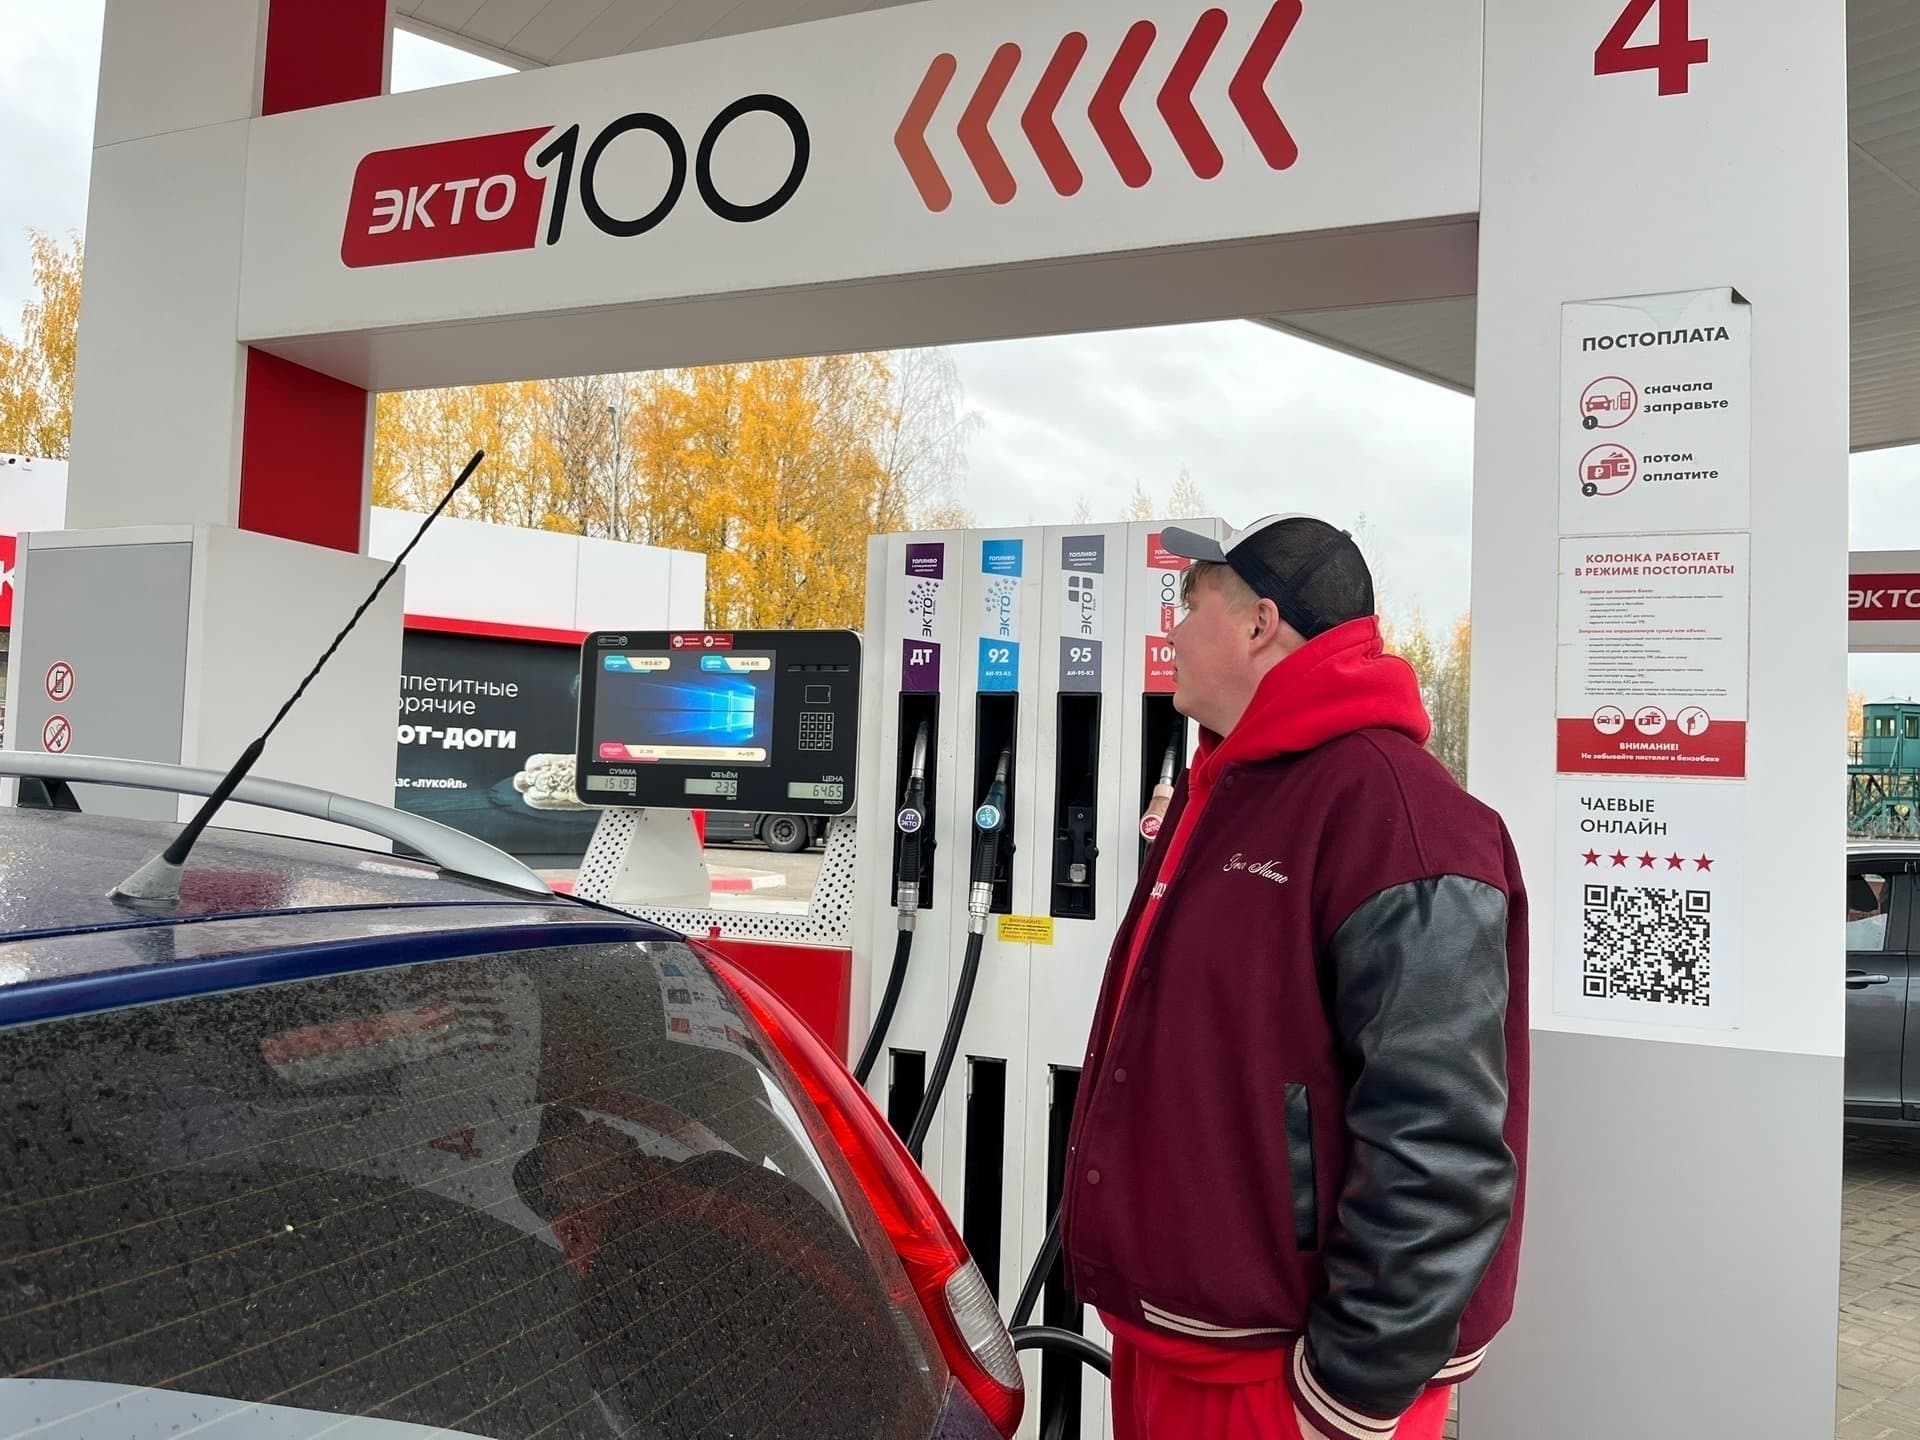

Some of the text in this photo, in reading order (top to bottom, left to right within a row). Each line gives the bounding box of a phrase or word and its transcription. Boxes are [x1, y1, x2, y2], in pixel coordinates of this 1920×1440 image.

[1594, 0, 1708, 96] 4
[368, 93, 811, 246] ЭКТО 100
[1582, 326, 1730, 352] ПОСТОПЛАТА
[1644, 381, 1713, 395] сначала
[1644, 399, 1729, 414] заправьте
[1643, 453, 1693, 464] потом
[1643, 469, 1719, 482] оплатите
[1586, 551, 1720, 564] КОЛОНКА РАБОТАЕТ
[1575, 565, 1734, 577] В РЕЖИМЕ ПОСТОПЛАТЫ
[922, 597, 933, 638] ЭКТО
[1000, 595, 1011, 637] ЭКТО
[1081, 591, 1093, 635] ЭКТО
[910, 648, 933, 666] ДТ
[988, 648, 1010, 663] 92
[1070, 647, 1092, 662] 95
[399, 675, 519, 697] ппетитные
[397, 725, 517, 750] от-доги
[1619, 742, 1679, 751] ВНИМАНИЕ!
[710, 771, 738, 779] ОБЪЁМ
[412, 778, 467, 789] «ЛУКОЙЛ»
[1581, 797, 1655, 813] ЧАЕВЫЕ
[1580, 817, 1667, 836] ОНЛАЙН
